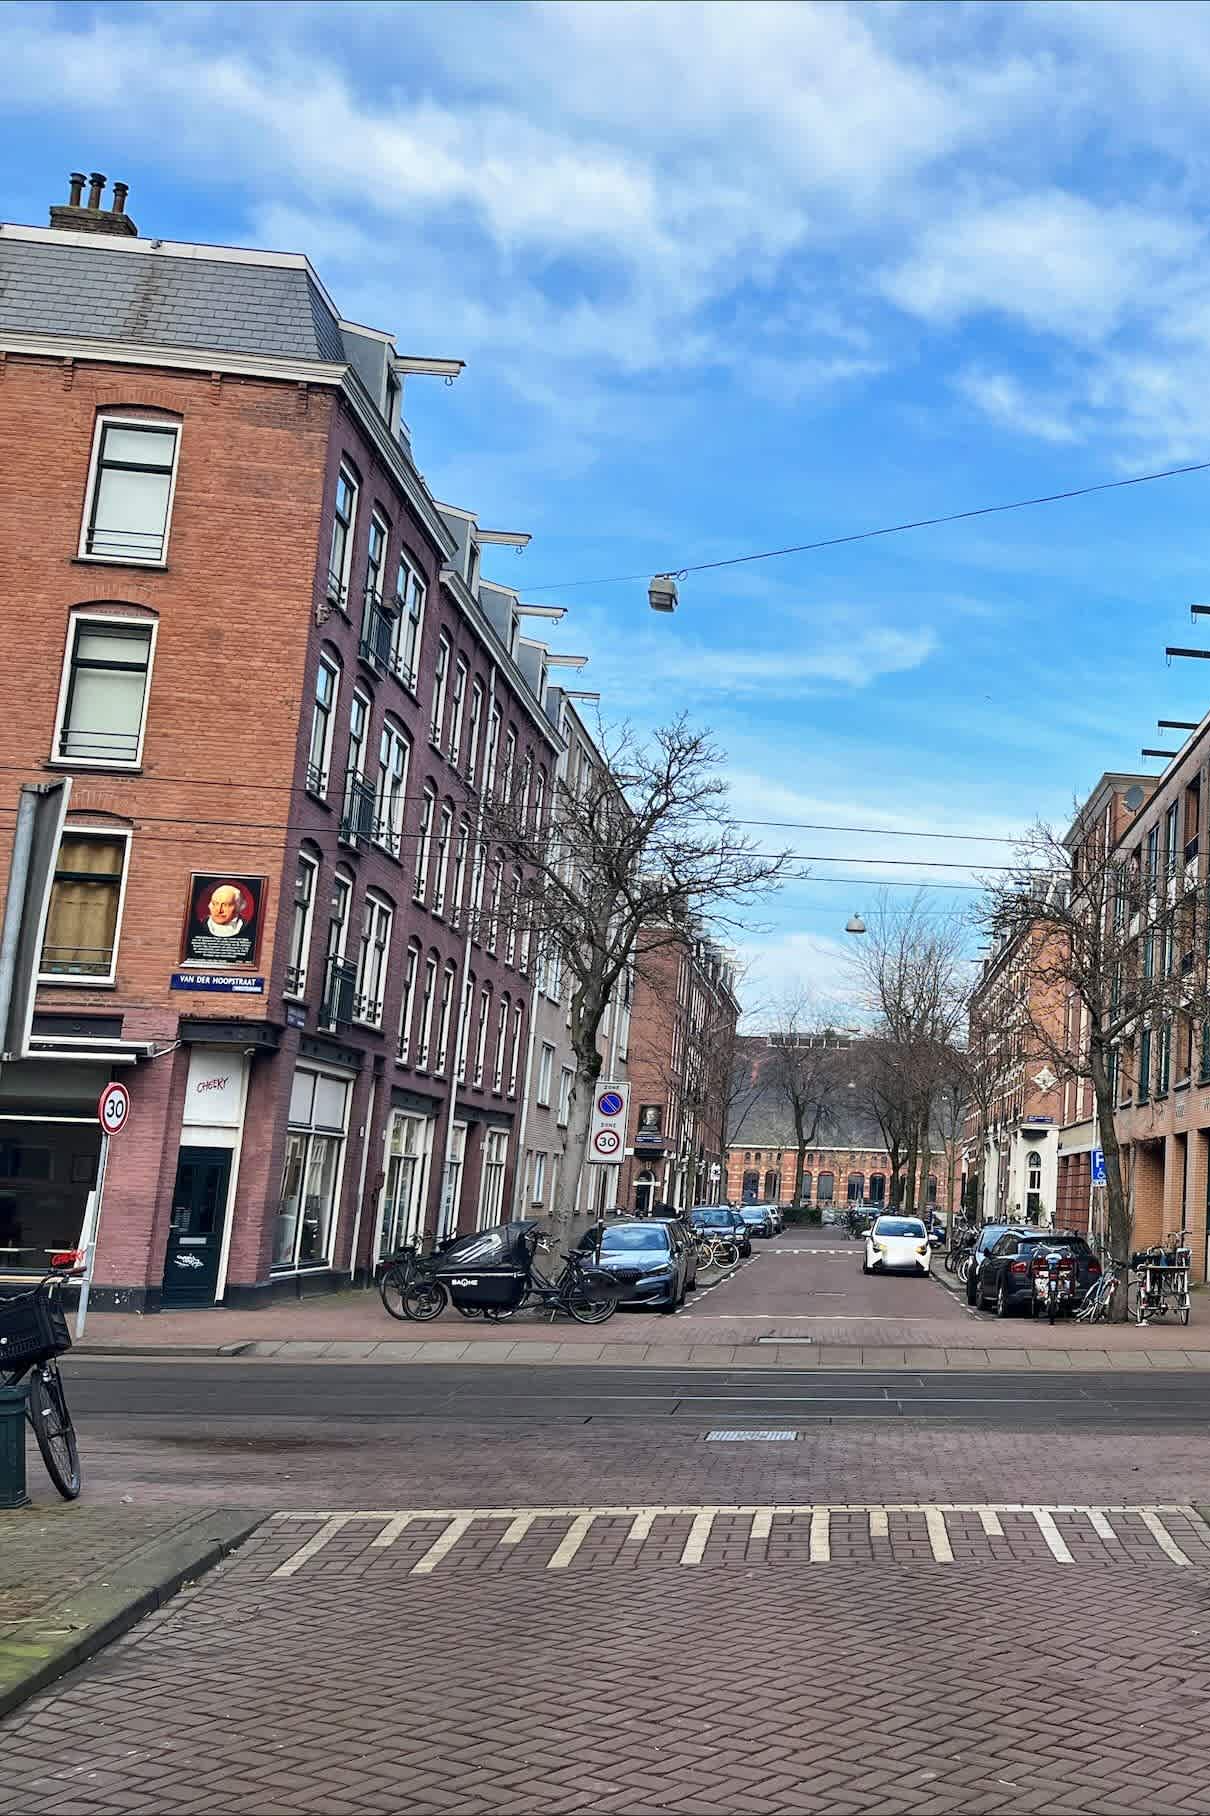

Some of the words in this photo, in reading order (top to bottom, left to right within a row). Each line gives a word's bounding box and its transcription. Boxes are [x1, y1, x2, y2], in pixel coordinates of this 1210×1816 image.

[180, 975, 194, 984] VAN
[196, 976, 210, 985] DER
[196, 1076, 229, 1093] CHEEKY
[106, 1099, 125, 1118] 30
[598, 1136, 617, 1148] 30
